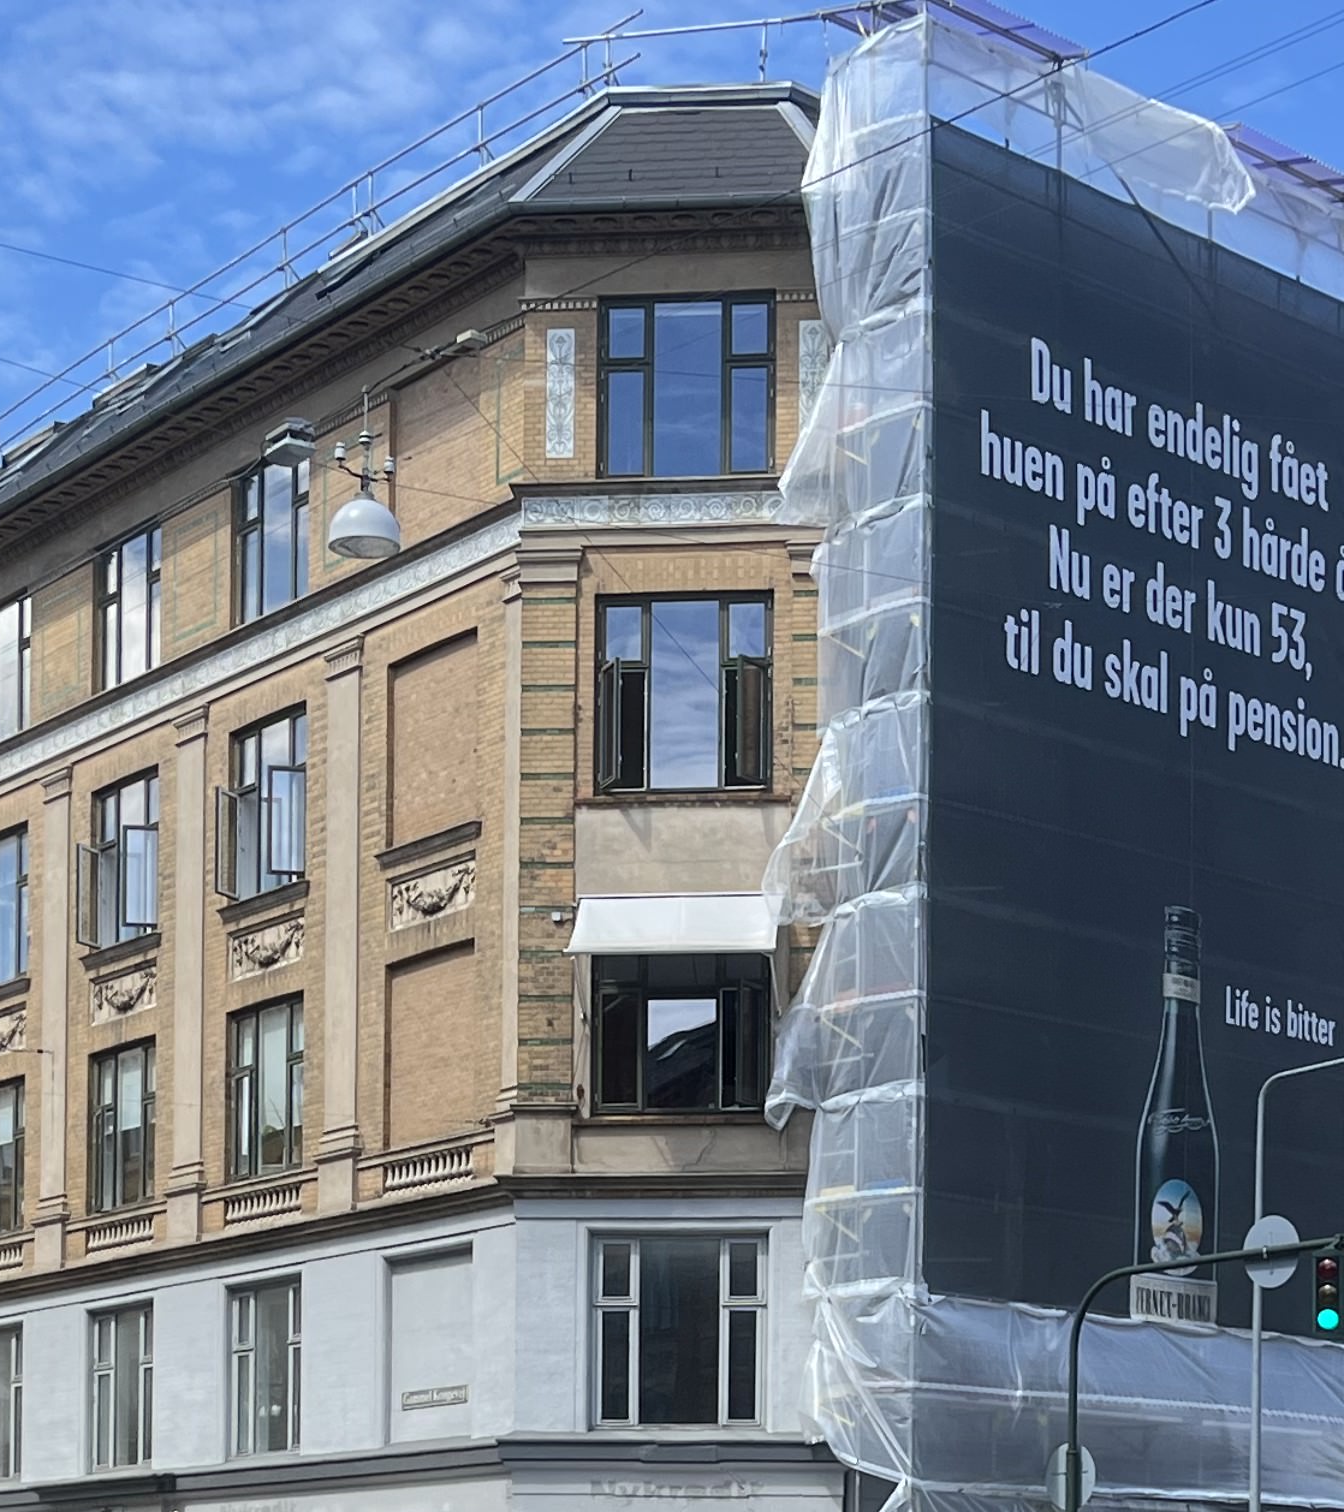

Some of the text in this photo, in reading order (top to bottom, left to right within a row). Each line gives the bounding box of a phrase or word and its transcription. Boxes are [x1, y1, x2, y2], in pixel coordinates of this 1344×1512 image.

[980, 408, 1065, 502] huen
[1076, 456, 1116, 526] på
[1127, 472, 1204, 550] efter
[1214, 495, 1232, 560] 3
[1242, 506, 1327, 593] hårde
[1031, 337, 1330, 512] Du har endelig fået
[1003, 608, 1040, 676] til
[1052, 619, 1093, 692] du
[1104, 638, 1169, 715] skal
[1179, 668, 1217, 738] på
[1048, 523, 1314, 682] Nu er der kun 53,
[1224, 984, 1337, 1047] Life is bitter
